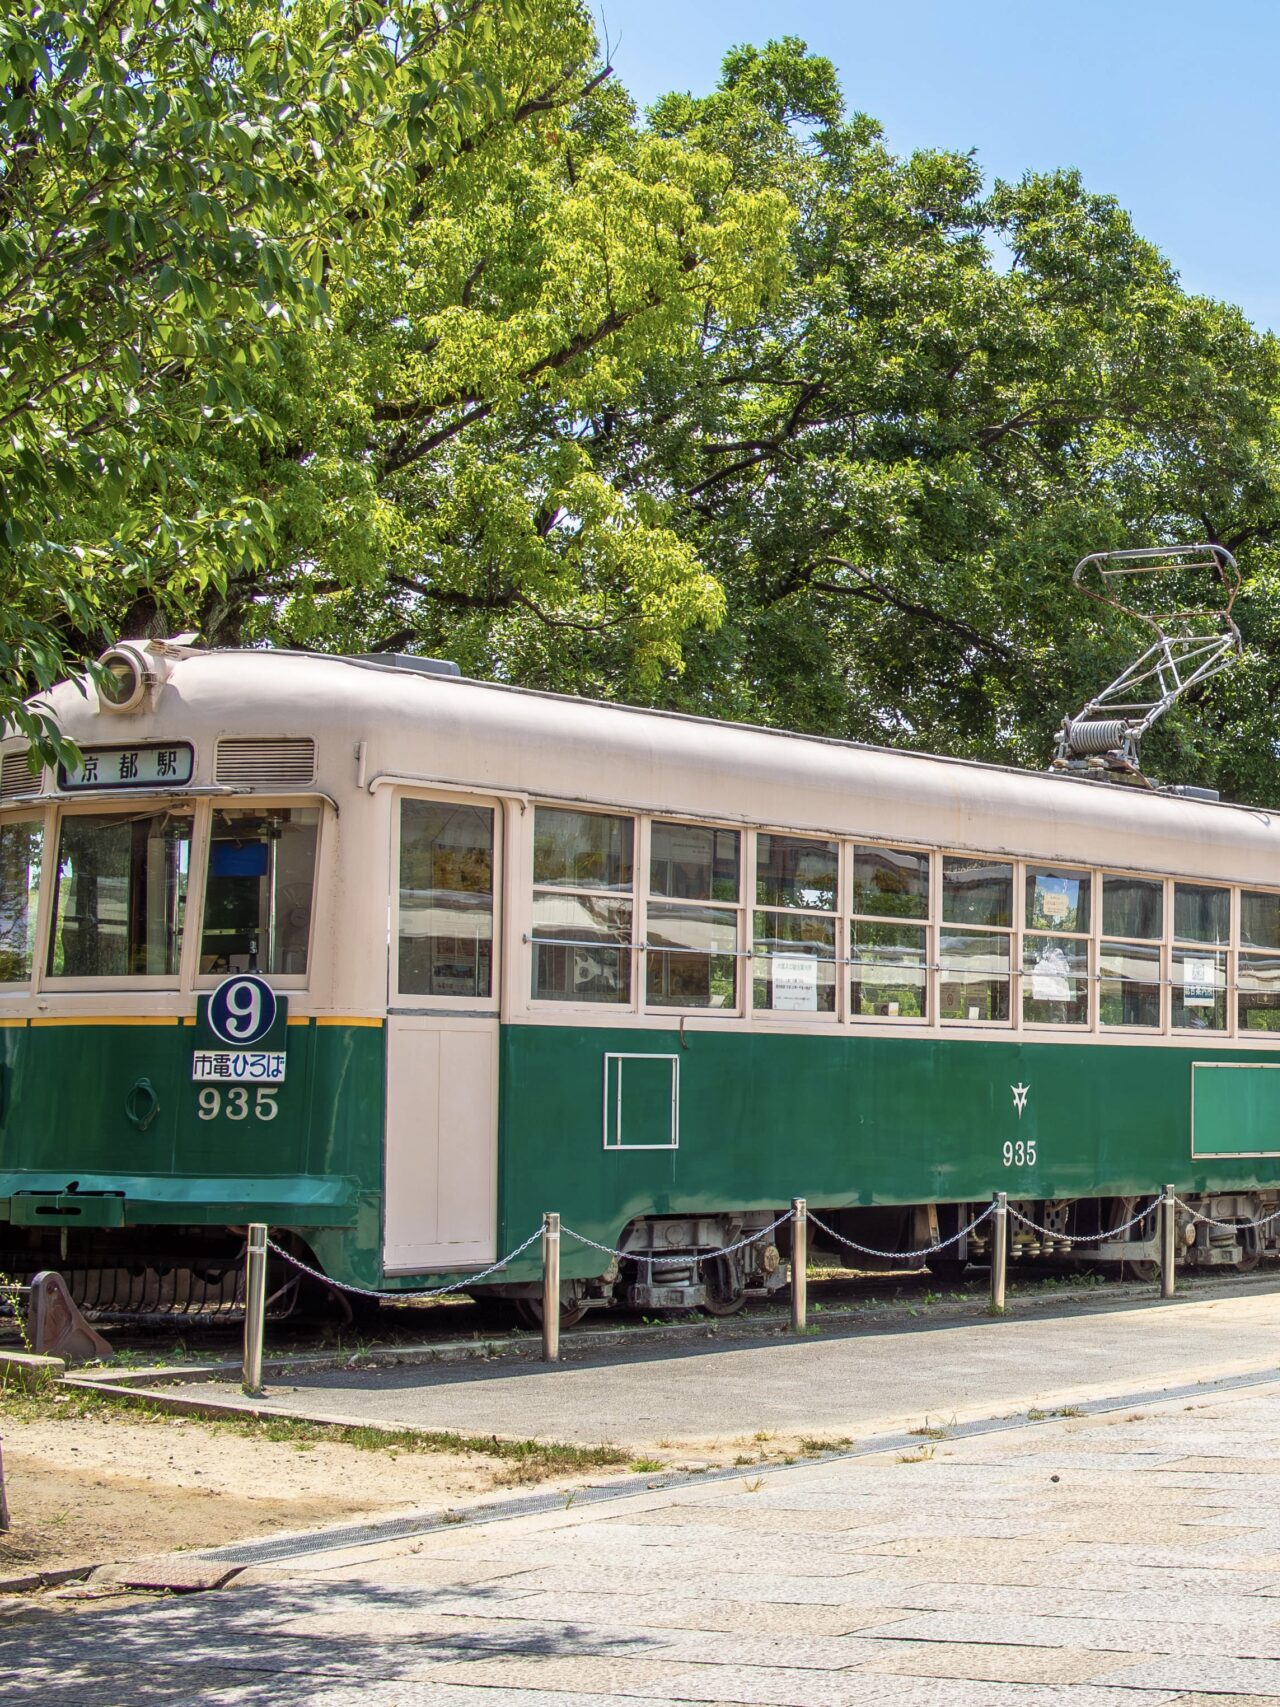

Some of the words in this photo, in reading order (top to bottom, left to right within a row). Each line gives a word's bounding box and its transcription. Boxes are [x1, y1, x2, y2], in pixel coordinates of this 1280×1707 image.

[81, 751, 177, 782] 京都駅
[225, 981, 262, 1038] 9
[194, 1053, 285, 1078] 市電ひろば
[198, 1087, 278, 1120] 935
[1003, 1140, 1037, 1167] 935
